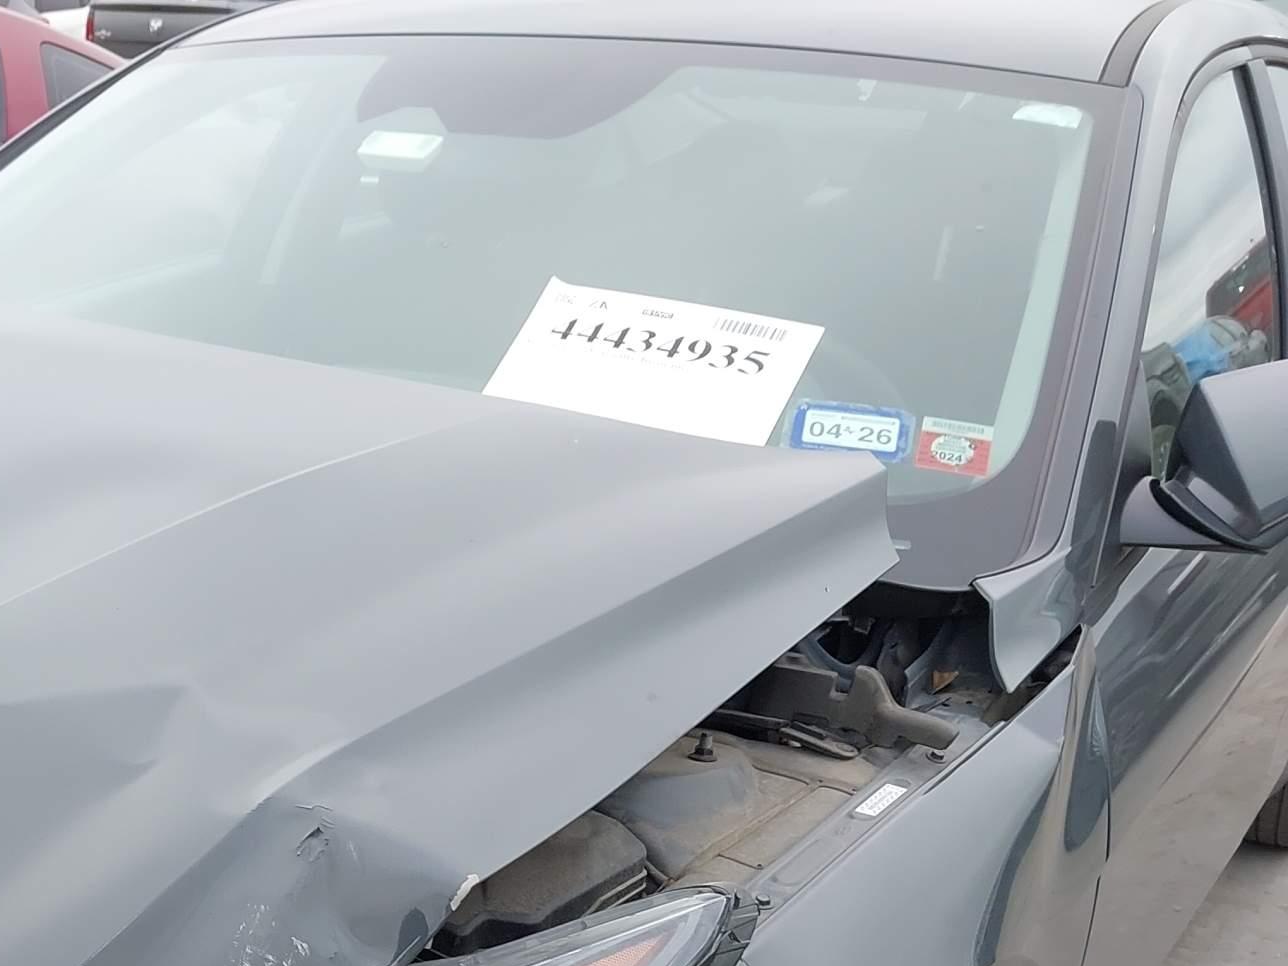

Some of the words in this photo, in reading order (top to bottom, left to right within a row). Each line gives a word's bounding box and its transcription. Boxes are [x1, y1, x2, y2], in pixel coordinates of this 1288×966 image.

[551, 318, 772, 375] 44434935
[809, 421, 843, 440] 04
[858, 426, 893, 446] 26
